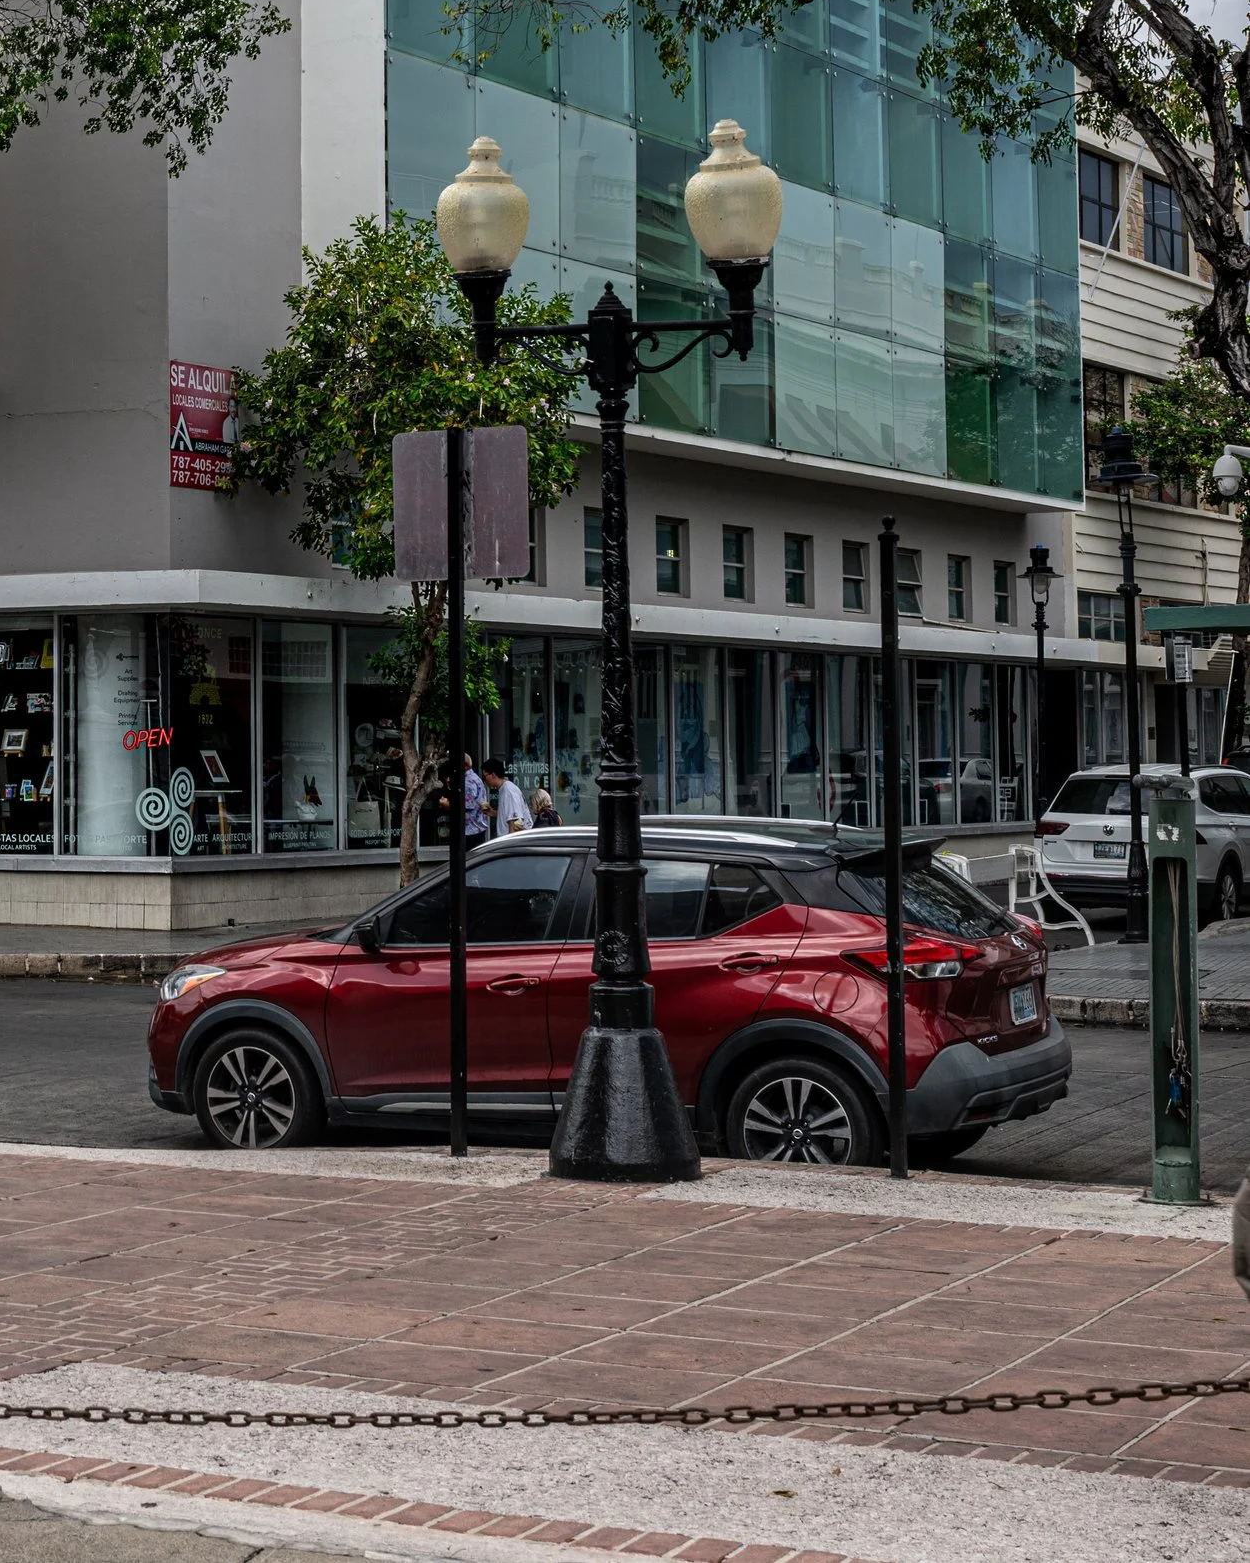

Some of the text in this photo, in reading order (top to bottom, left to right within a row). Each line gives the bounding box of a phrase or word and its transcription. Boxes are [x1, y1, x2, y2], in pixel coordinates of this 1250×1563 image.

[170, 364, 186, 387] SE
[172, 394, 228, 413] LOCALES COMERCIALES
[195, 442, 220, 454] ABRAHAM
[123, 727, 174, 751] OPEN
[520, 761, 549, 774] Vitrinas
[18, 834, 55, 843] LOCALES
[193, 833, 209, 843] ARTE
[268, 830, 332, 841] IMPRESIÓN DE PLANOS
[350, 829, 367, 838] FOTOS
[368, 829, 376, 838] DE
[977, 1035, 998, 1045] KICKS
